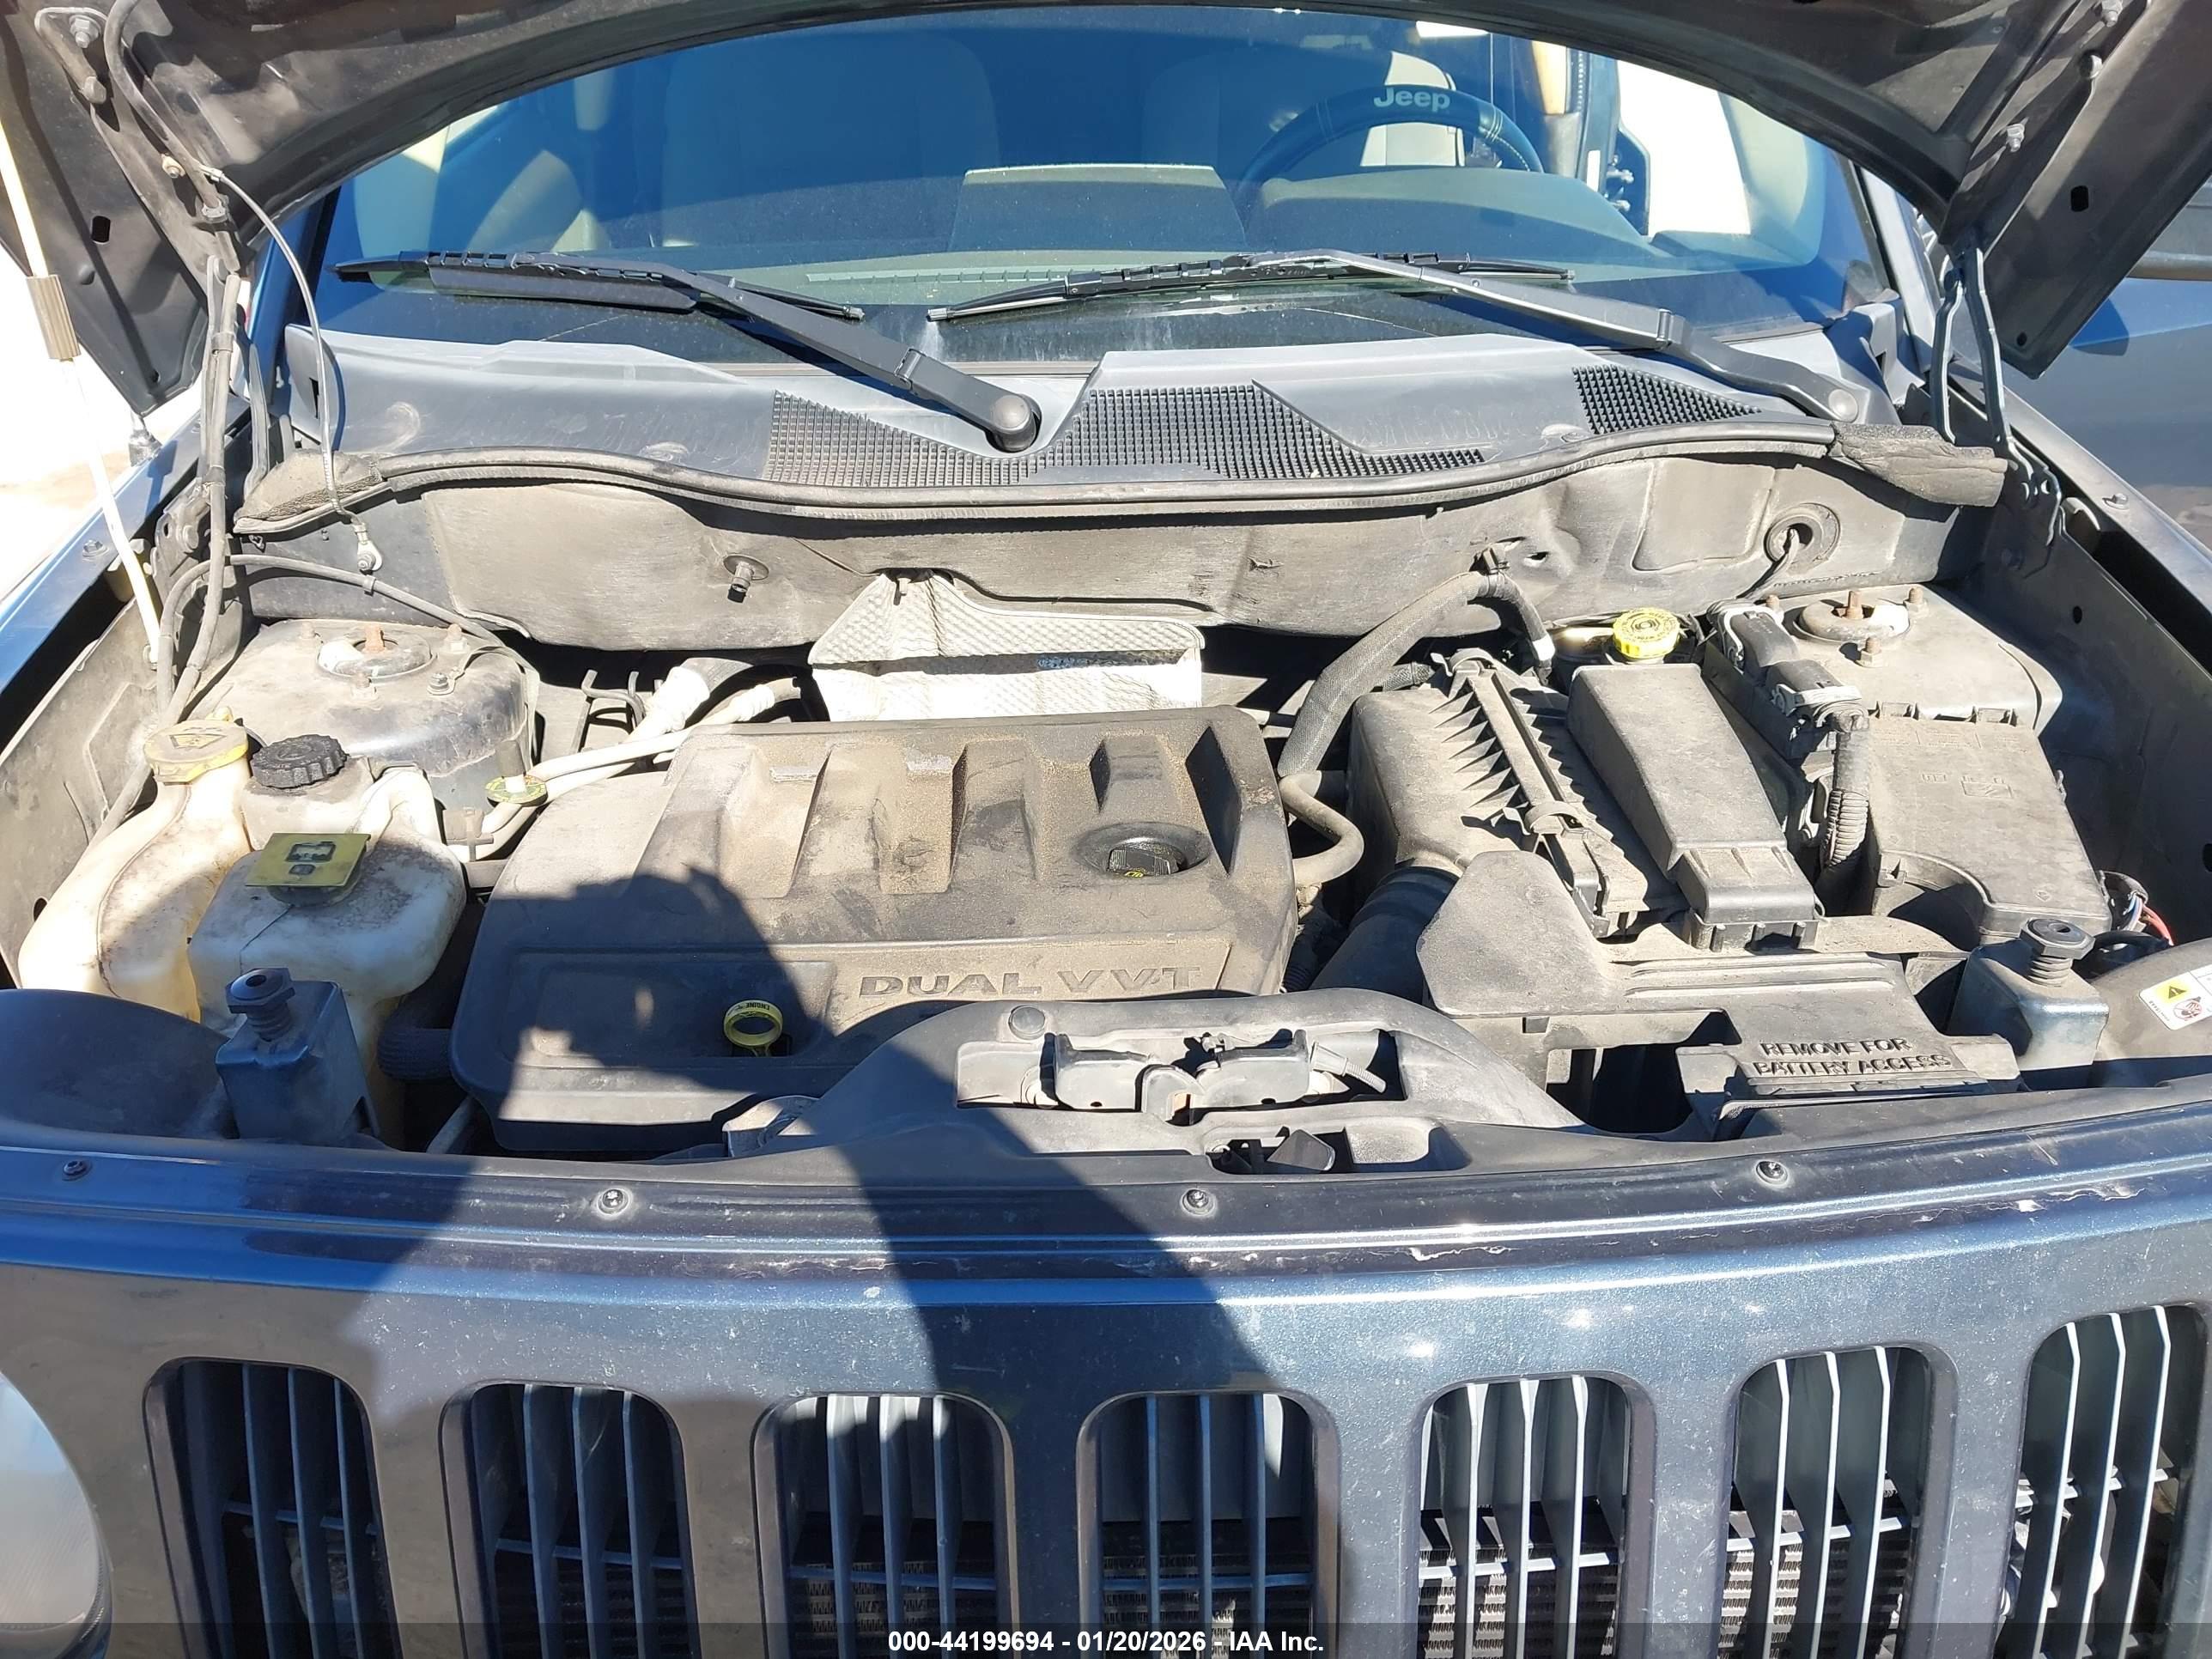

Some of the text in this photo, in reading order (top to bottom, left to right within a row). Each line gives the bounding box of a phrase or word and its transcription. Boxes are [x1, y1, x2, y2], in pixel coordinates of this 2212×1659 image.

[1373, 87, 1450, 112] Jeep
[859, 967, 1200, 998] DUAL VVT
[1760, 1037, 1912, 1056] REMOVE FOR
[1753, 1053, 1952, 1074] BATTERY ACCESS
